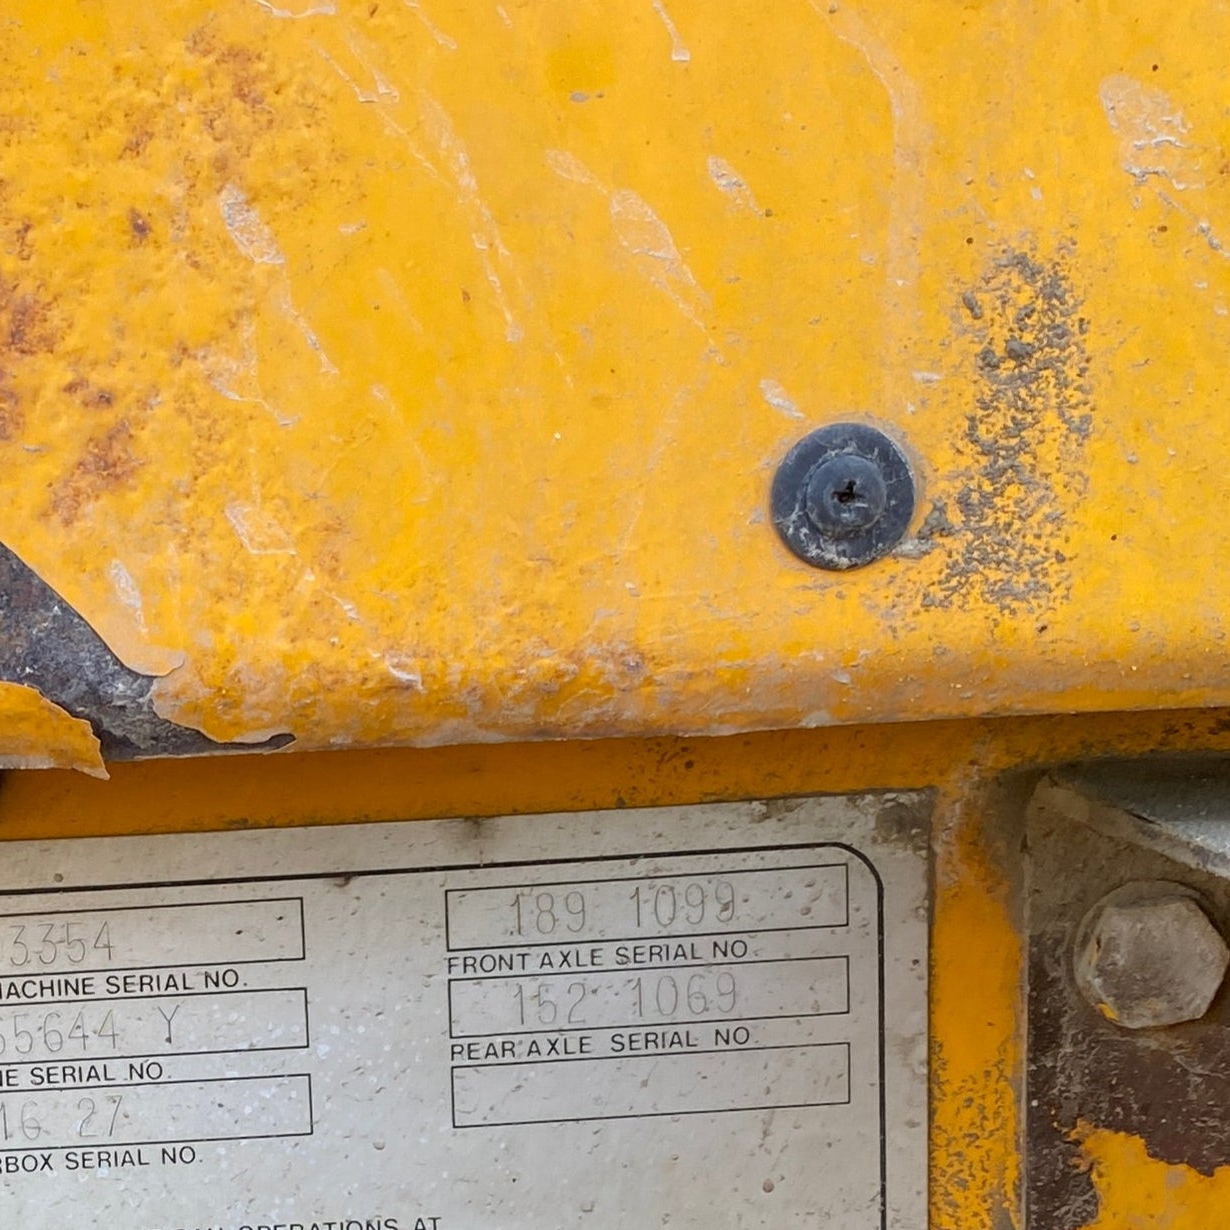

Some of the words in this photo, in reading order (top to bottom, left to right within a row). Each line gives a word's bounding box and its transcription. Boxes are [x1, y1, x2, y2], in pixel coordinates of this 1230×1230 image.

[510, 890, 587, 936] 189
[630, 881, 736, 928] 1099
[447, 952, 531, 975] FRONT
[539, 947, 603, 969] AXLE
[615, 943, 702, 966] SERIAL
[106, 973, 197, 996] SERIAL
[204, 968, 248, 989] NO.
[513, 982, 587, 1026] 152
[631, 970, 737, 1019] 1069
[158, 1004, 179, 1045] Y
[451, 1041, 516, 1062] REAR
[527, 1036, 593, 1057] AXLE
[611, 1030, 698, 1053] SERIAL
[30, 1063, 116, 1087] SERIAL
[77, 1095, 124, 1138] 27
[65, 1148, 150, 1171] SERIAL
[162, 1145, 203, 1166] NO.
